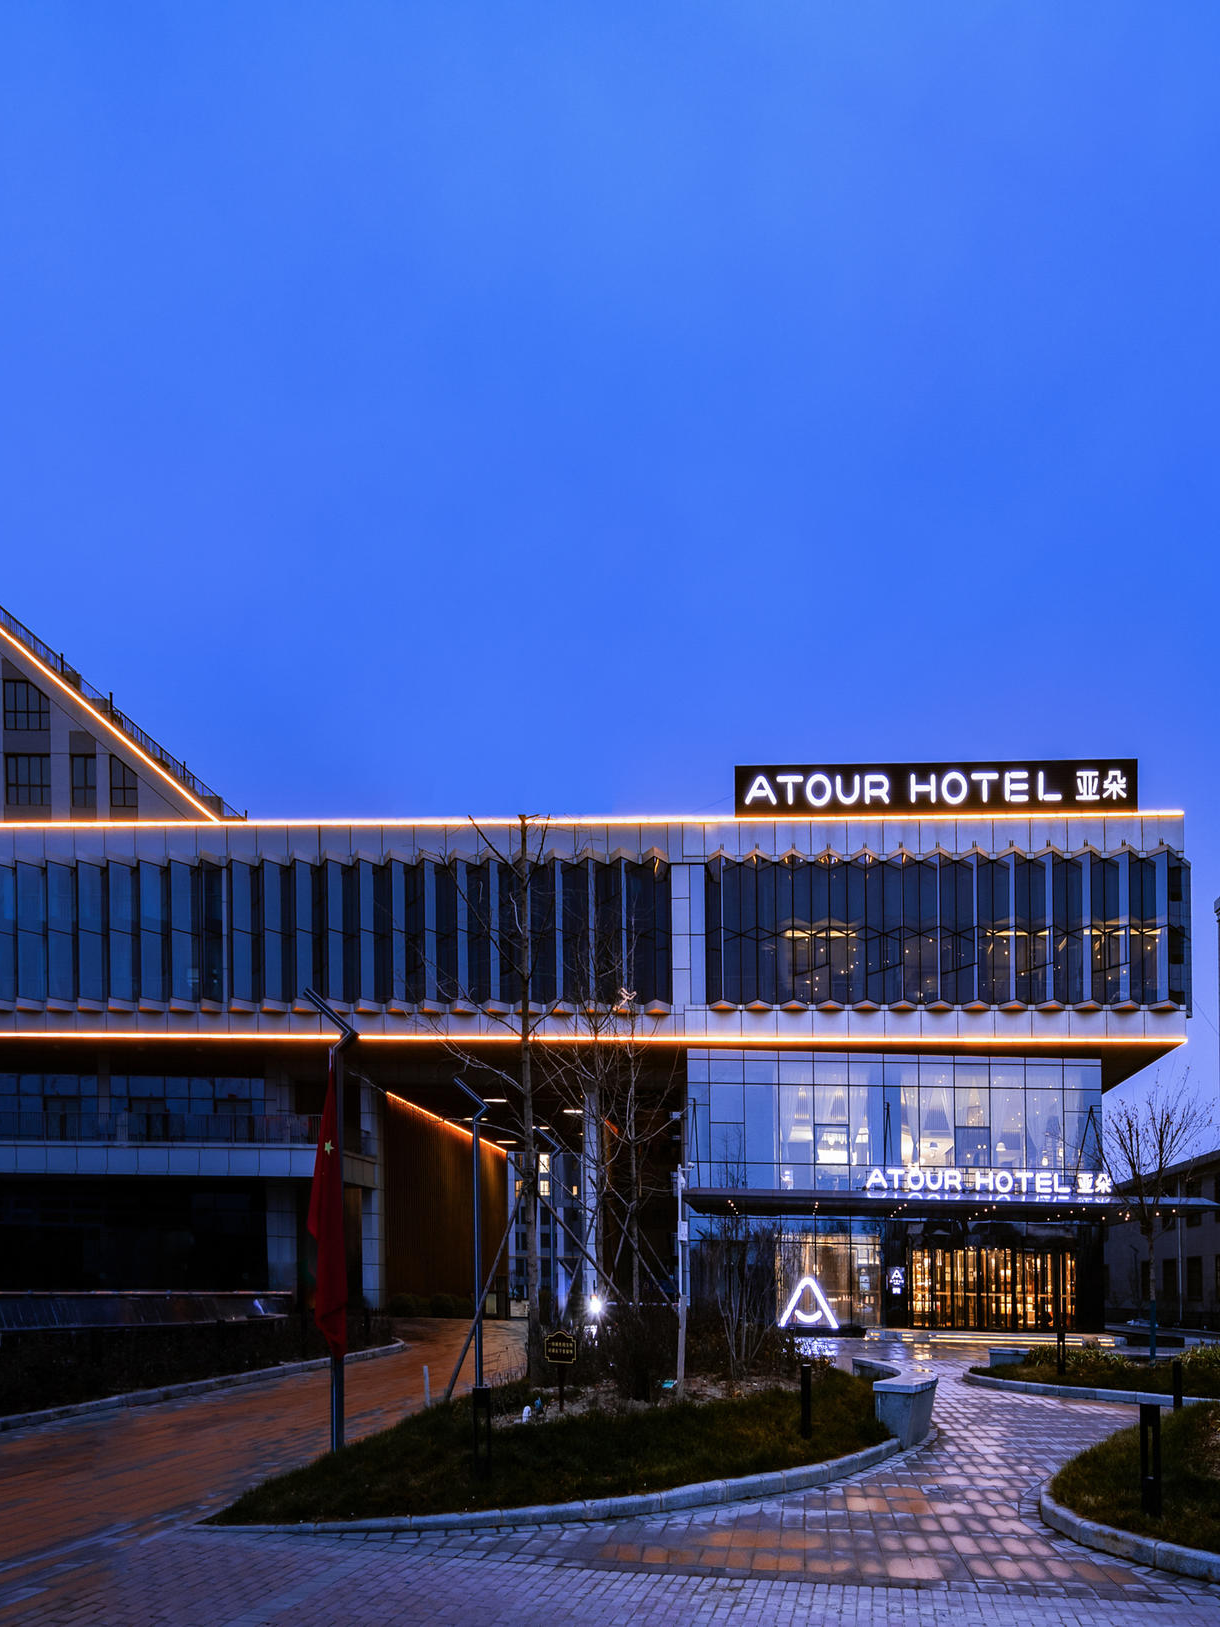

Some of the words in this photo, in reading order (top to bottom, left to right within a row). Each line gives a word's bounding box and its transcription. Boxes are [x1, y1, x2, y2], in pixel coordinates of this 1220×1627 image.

[744, 774, 890, 806] ATOUR
[909, 771, 1062, 804] HOTEL
[1075, 770, 1127, 801] 亚朵
[866, 1168, 962, 1191] ATOUR
[976, 1170, 1071, 1194] HOTEL
[1077, 1173, 1113, 1193] 亚朵
